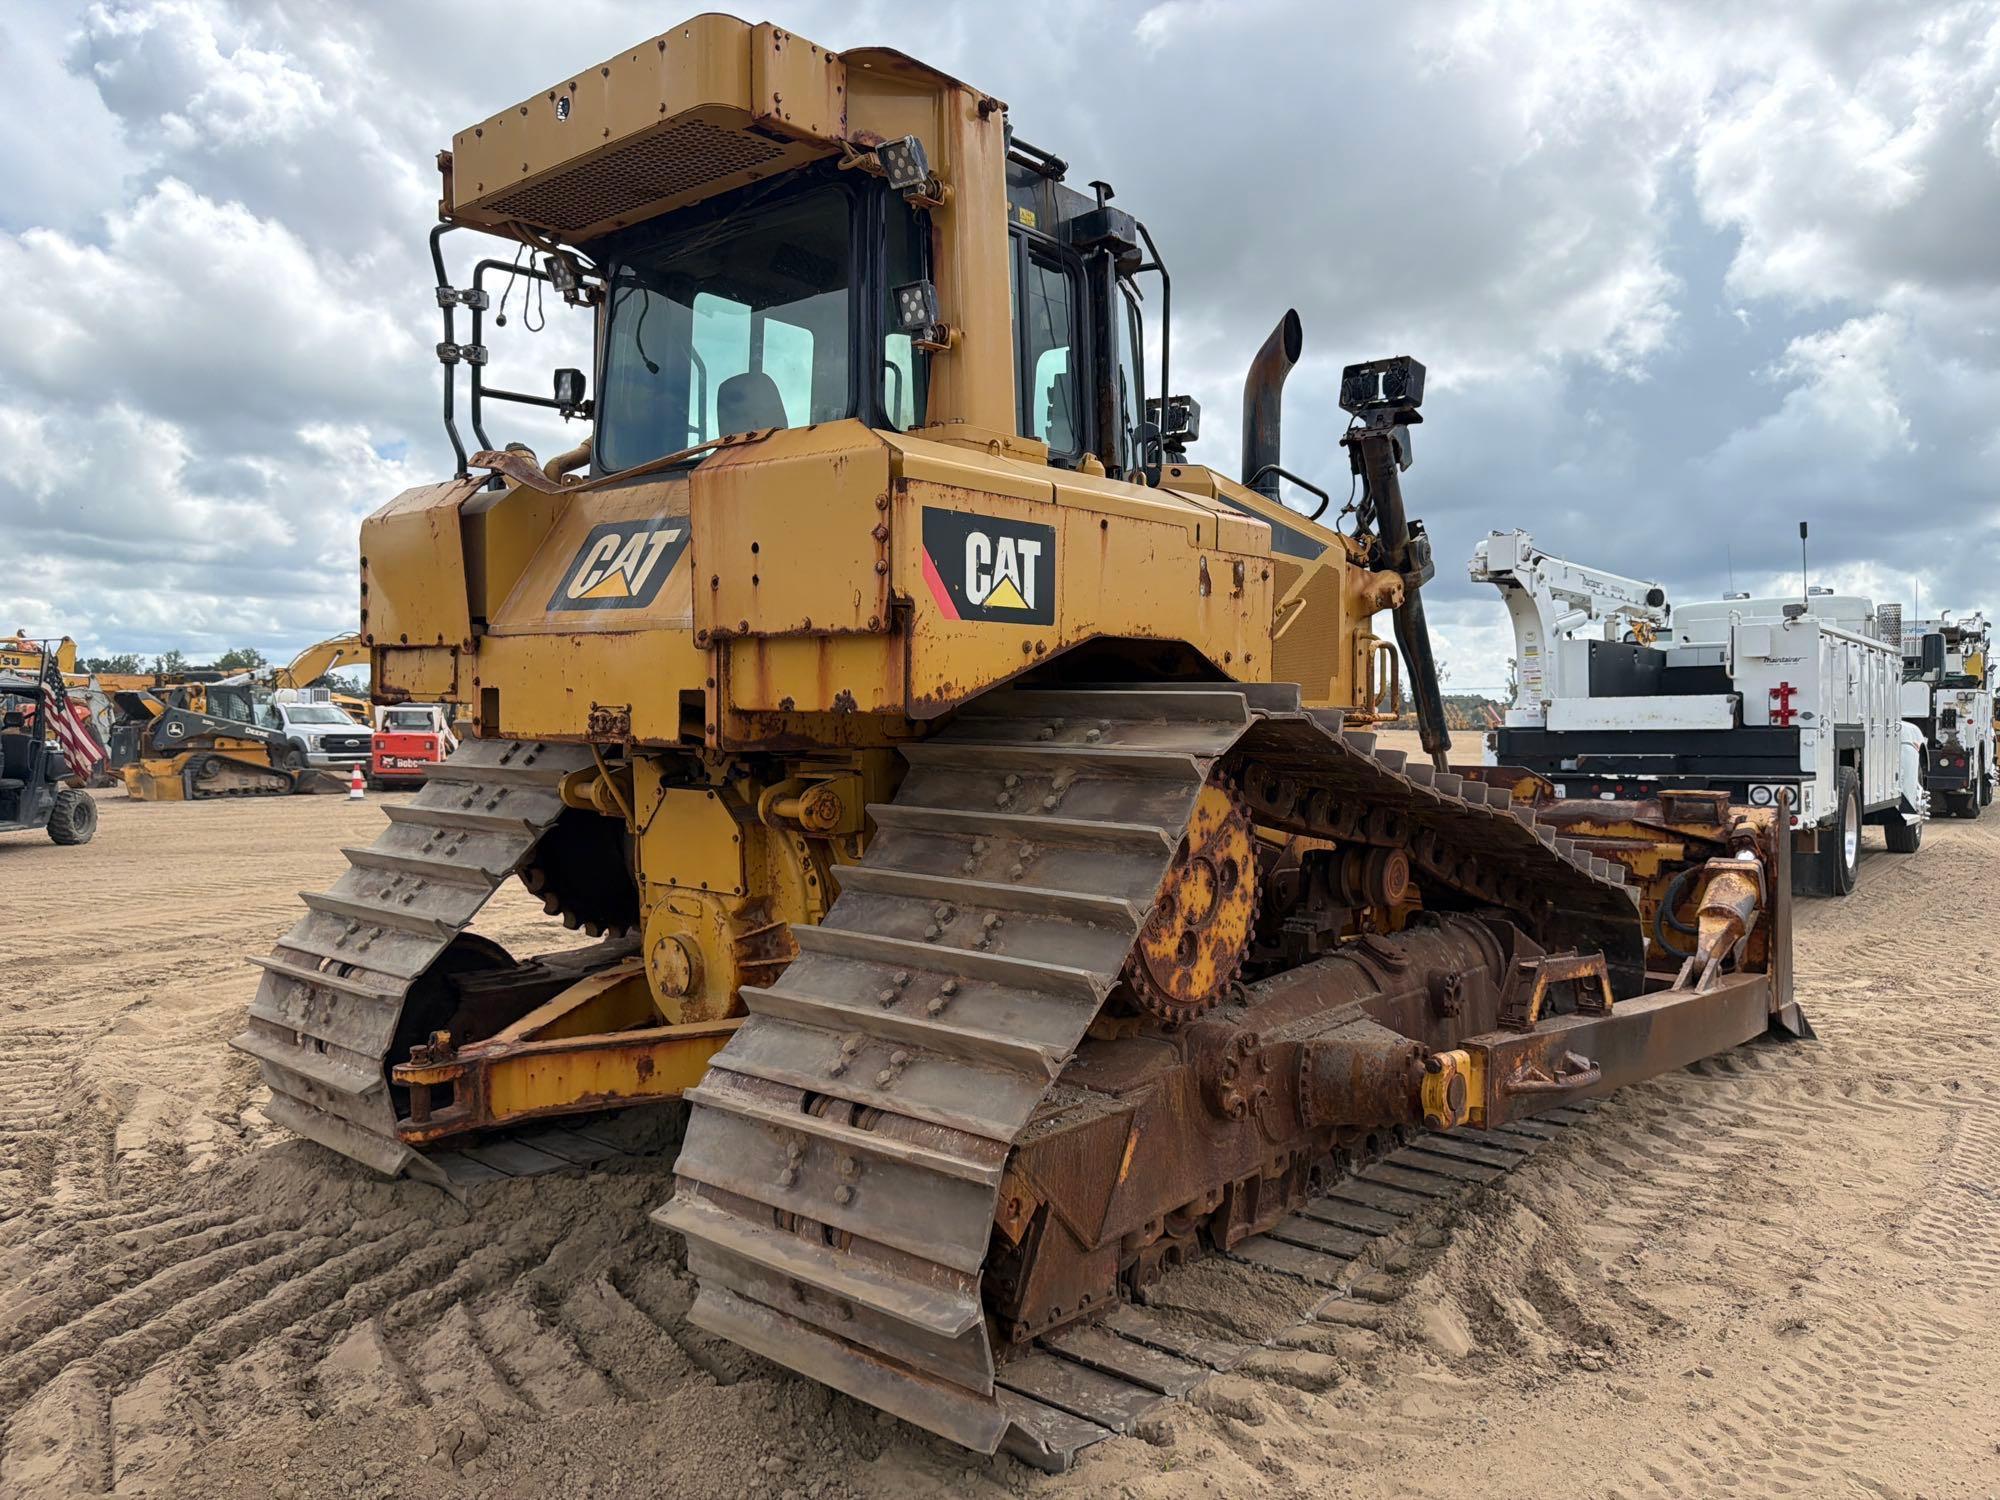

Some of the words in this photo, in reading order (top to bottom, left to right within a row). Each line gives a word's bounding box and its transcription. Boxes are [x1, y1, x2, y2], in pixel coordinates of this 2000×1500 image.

[567, 529, 681, 599] CAT
[966, 531, 1041, 610] CAT
[245, 727, 270, 738] DEERE
